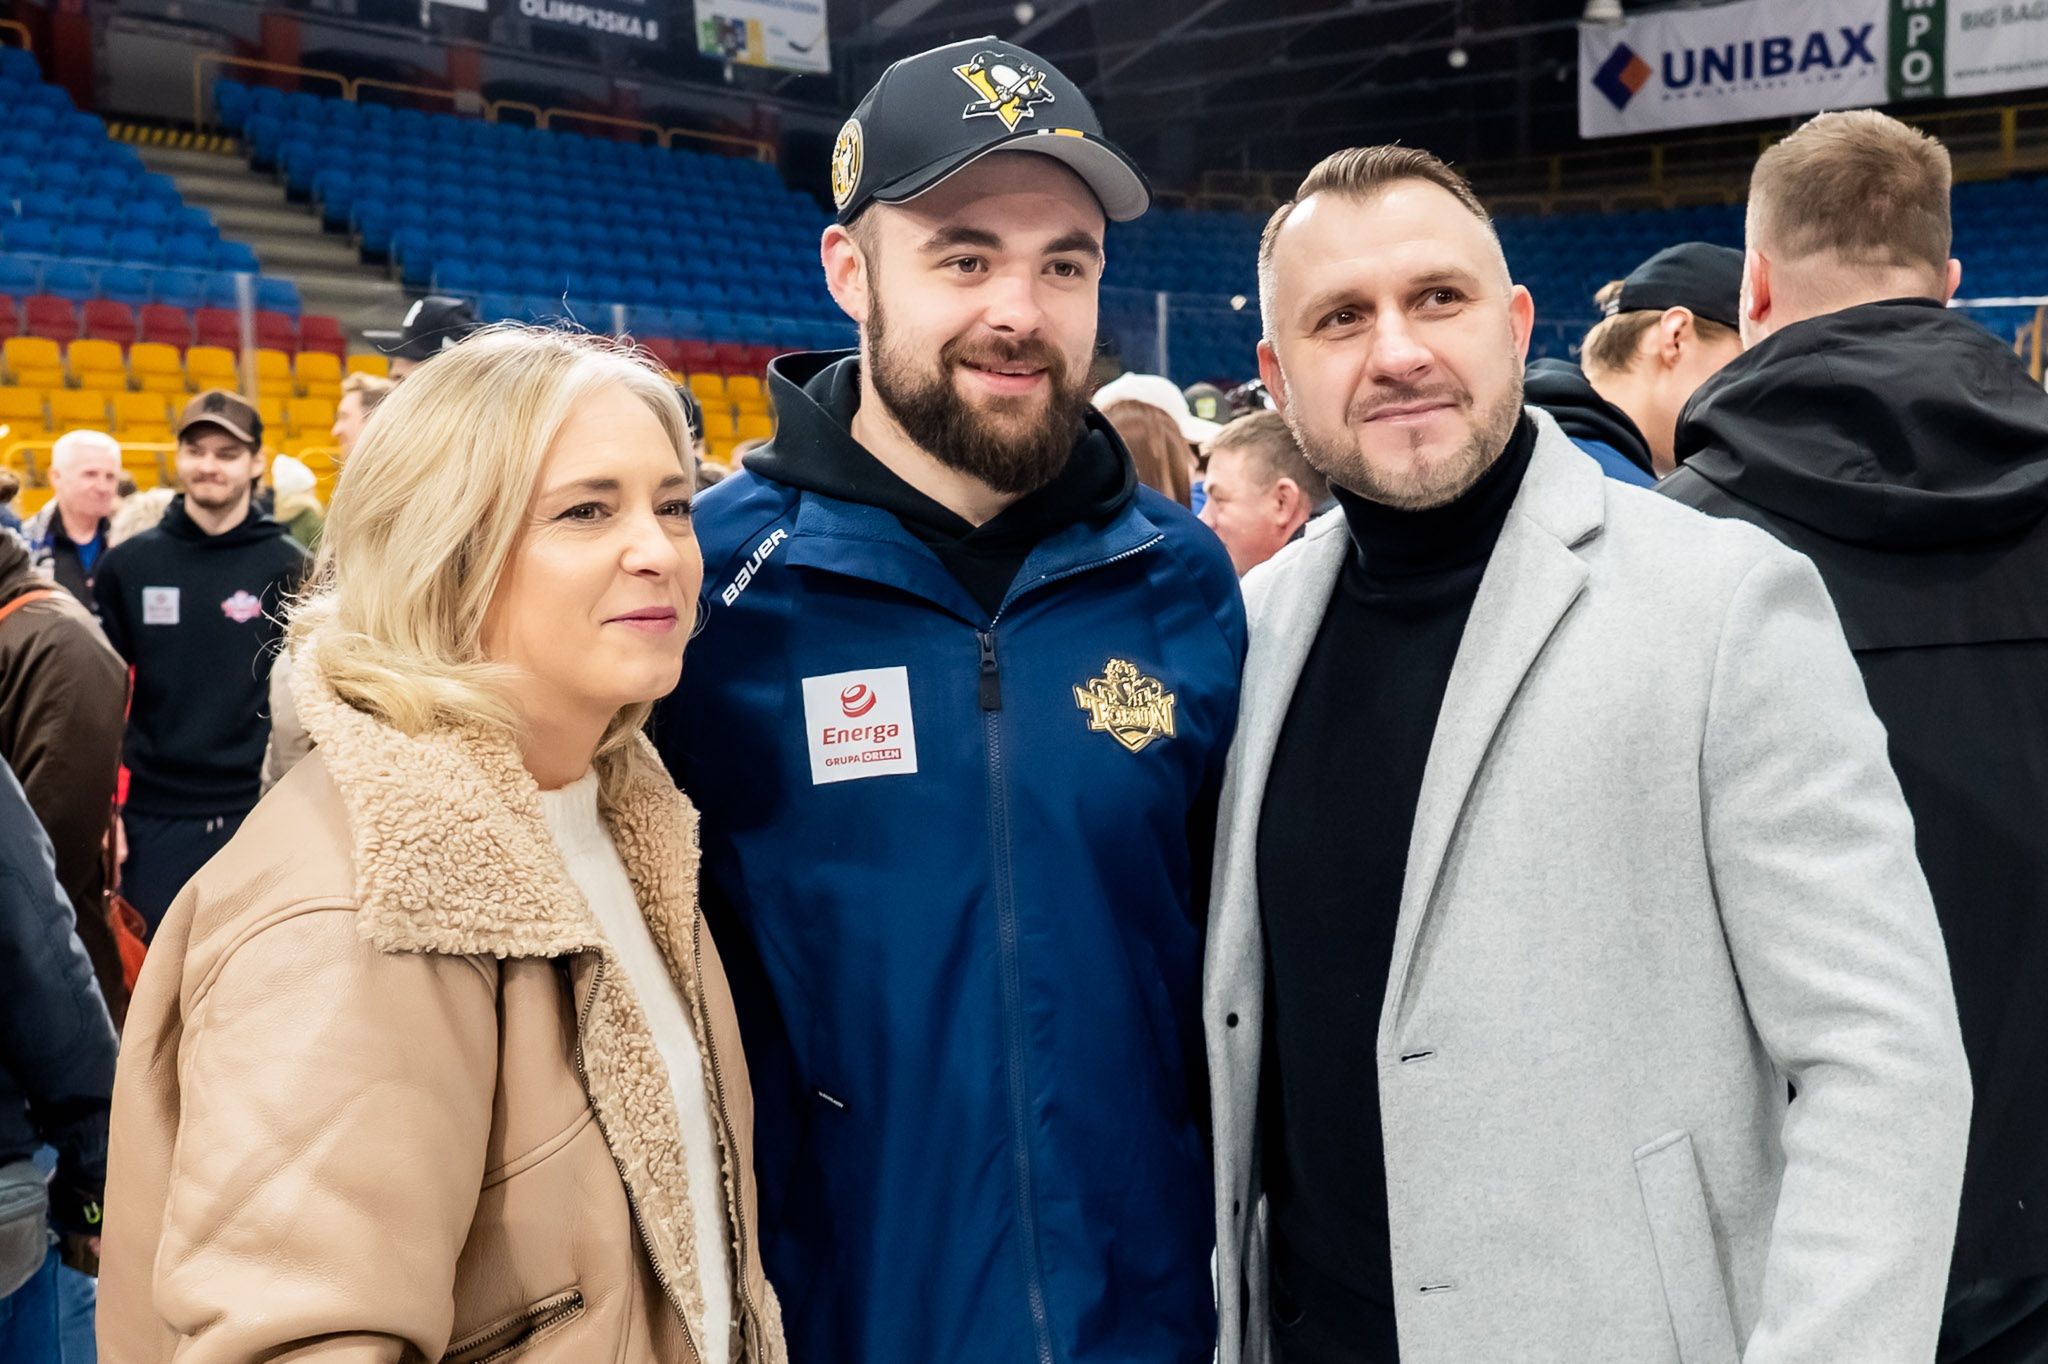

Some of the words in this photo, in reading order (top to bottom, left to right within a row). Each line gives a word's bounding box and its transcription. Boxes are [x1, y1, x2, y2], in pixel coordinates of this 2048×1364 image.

[1661, 22, 1876, 90] UNIBAX
[721, 528, 789, 608] BAUER
[822, 723, 900, 746] Energa
[825, 755, 861, 767] GRUPA
[863, 749, 900, 762] ORLEN
